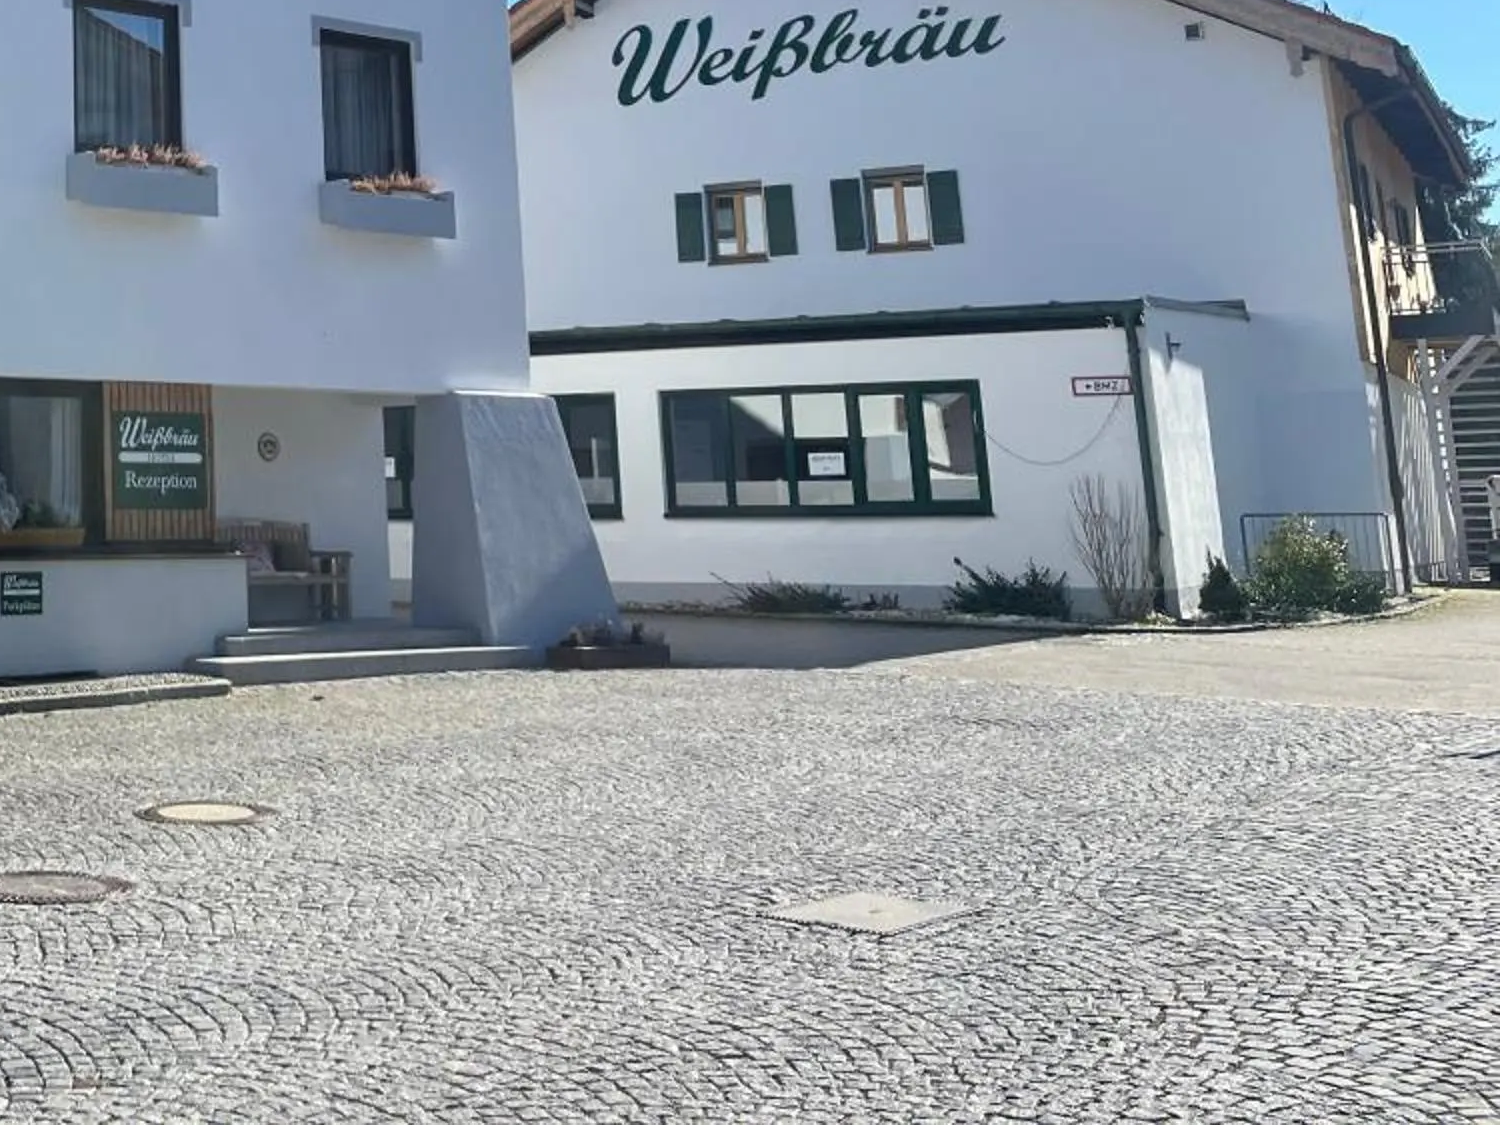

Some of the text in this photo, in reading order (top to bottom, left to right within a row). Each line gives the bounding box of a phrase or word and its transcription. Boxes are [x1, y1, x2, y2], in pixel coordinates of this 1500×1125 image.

[611, 6, 1006, 106] Weißbräu
[119, 416, 198, 451] Weißbräu
[124, 470, 197, 495] Rezeption
